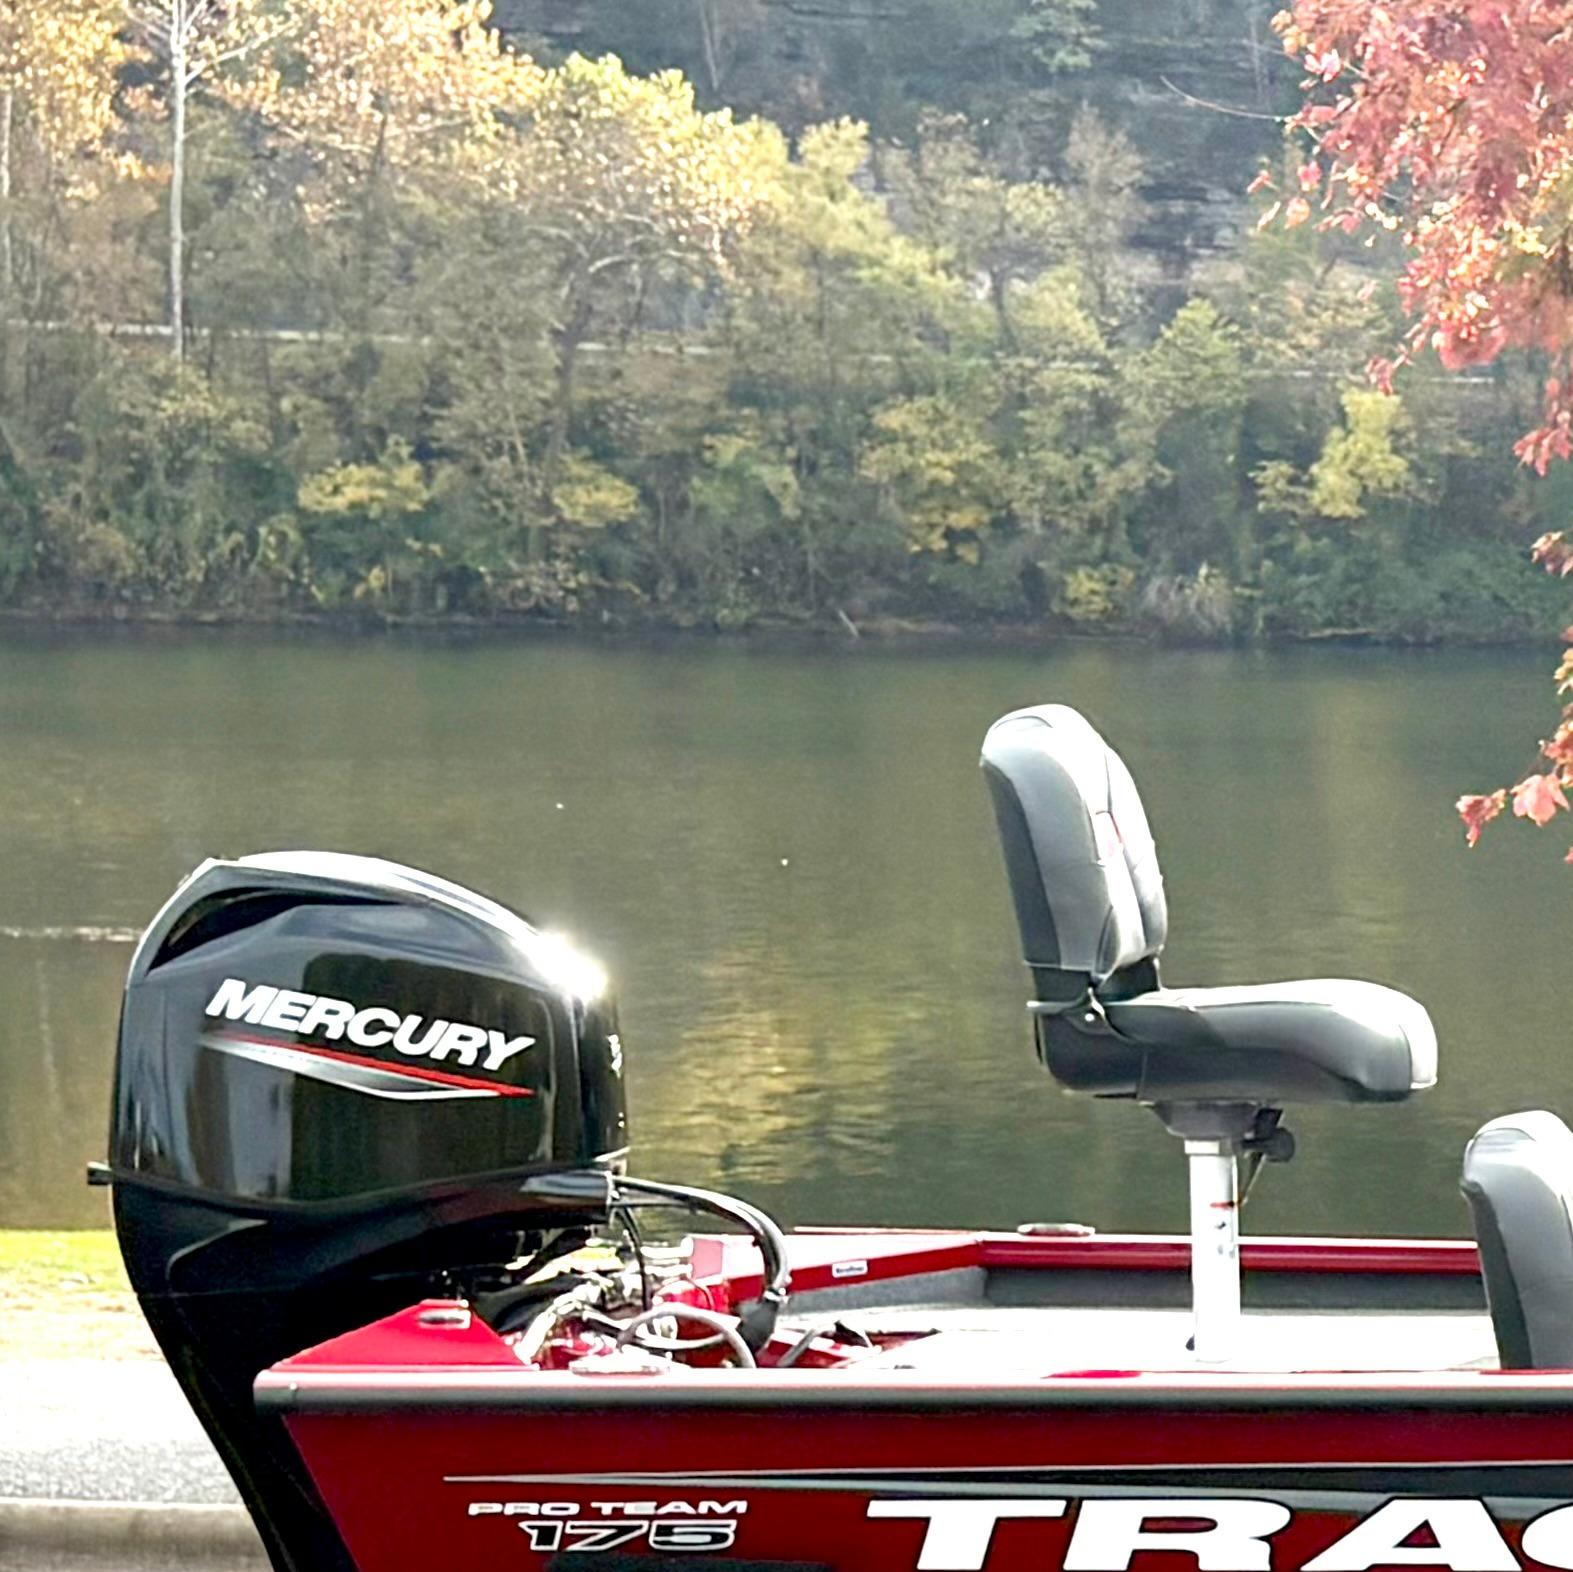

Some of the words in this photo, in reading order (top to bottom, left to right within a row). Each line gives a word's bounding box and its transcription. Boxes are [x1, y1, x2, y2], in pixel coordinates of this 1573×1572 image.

[205, 978, 536, 1071] MERCURY
[468, 1502, 580, 1515] PRO
[590, 1500, 748, 1515] TEAM
[517, 1518, 738, 1551] 175
